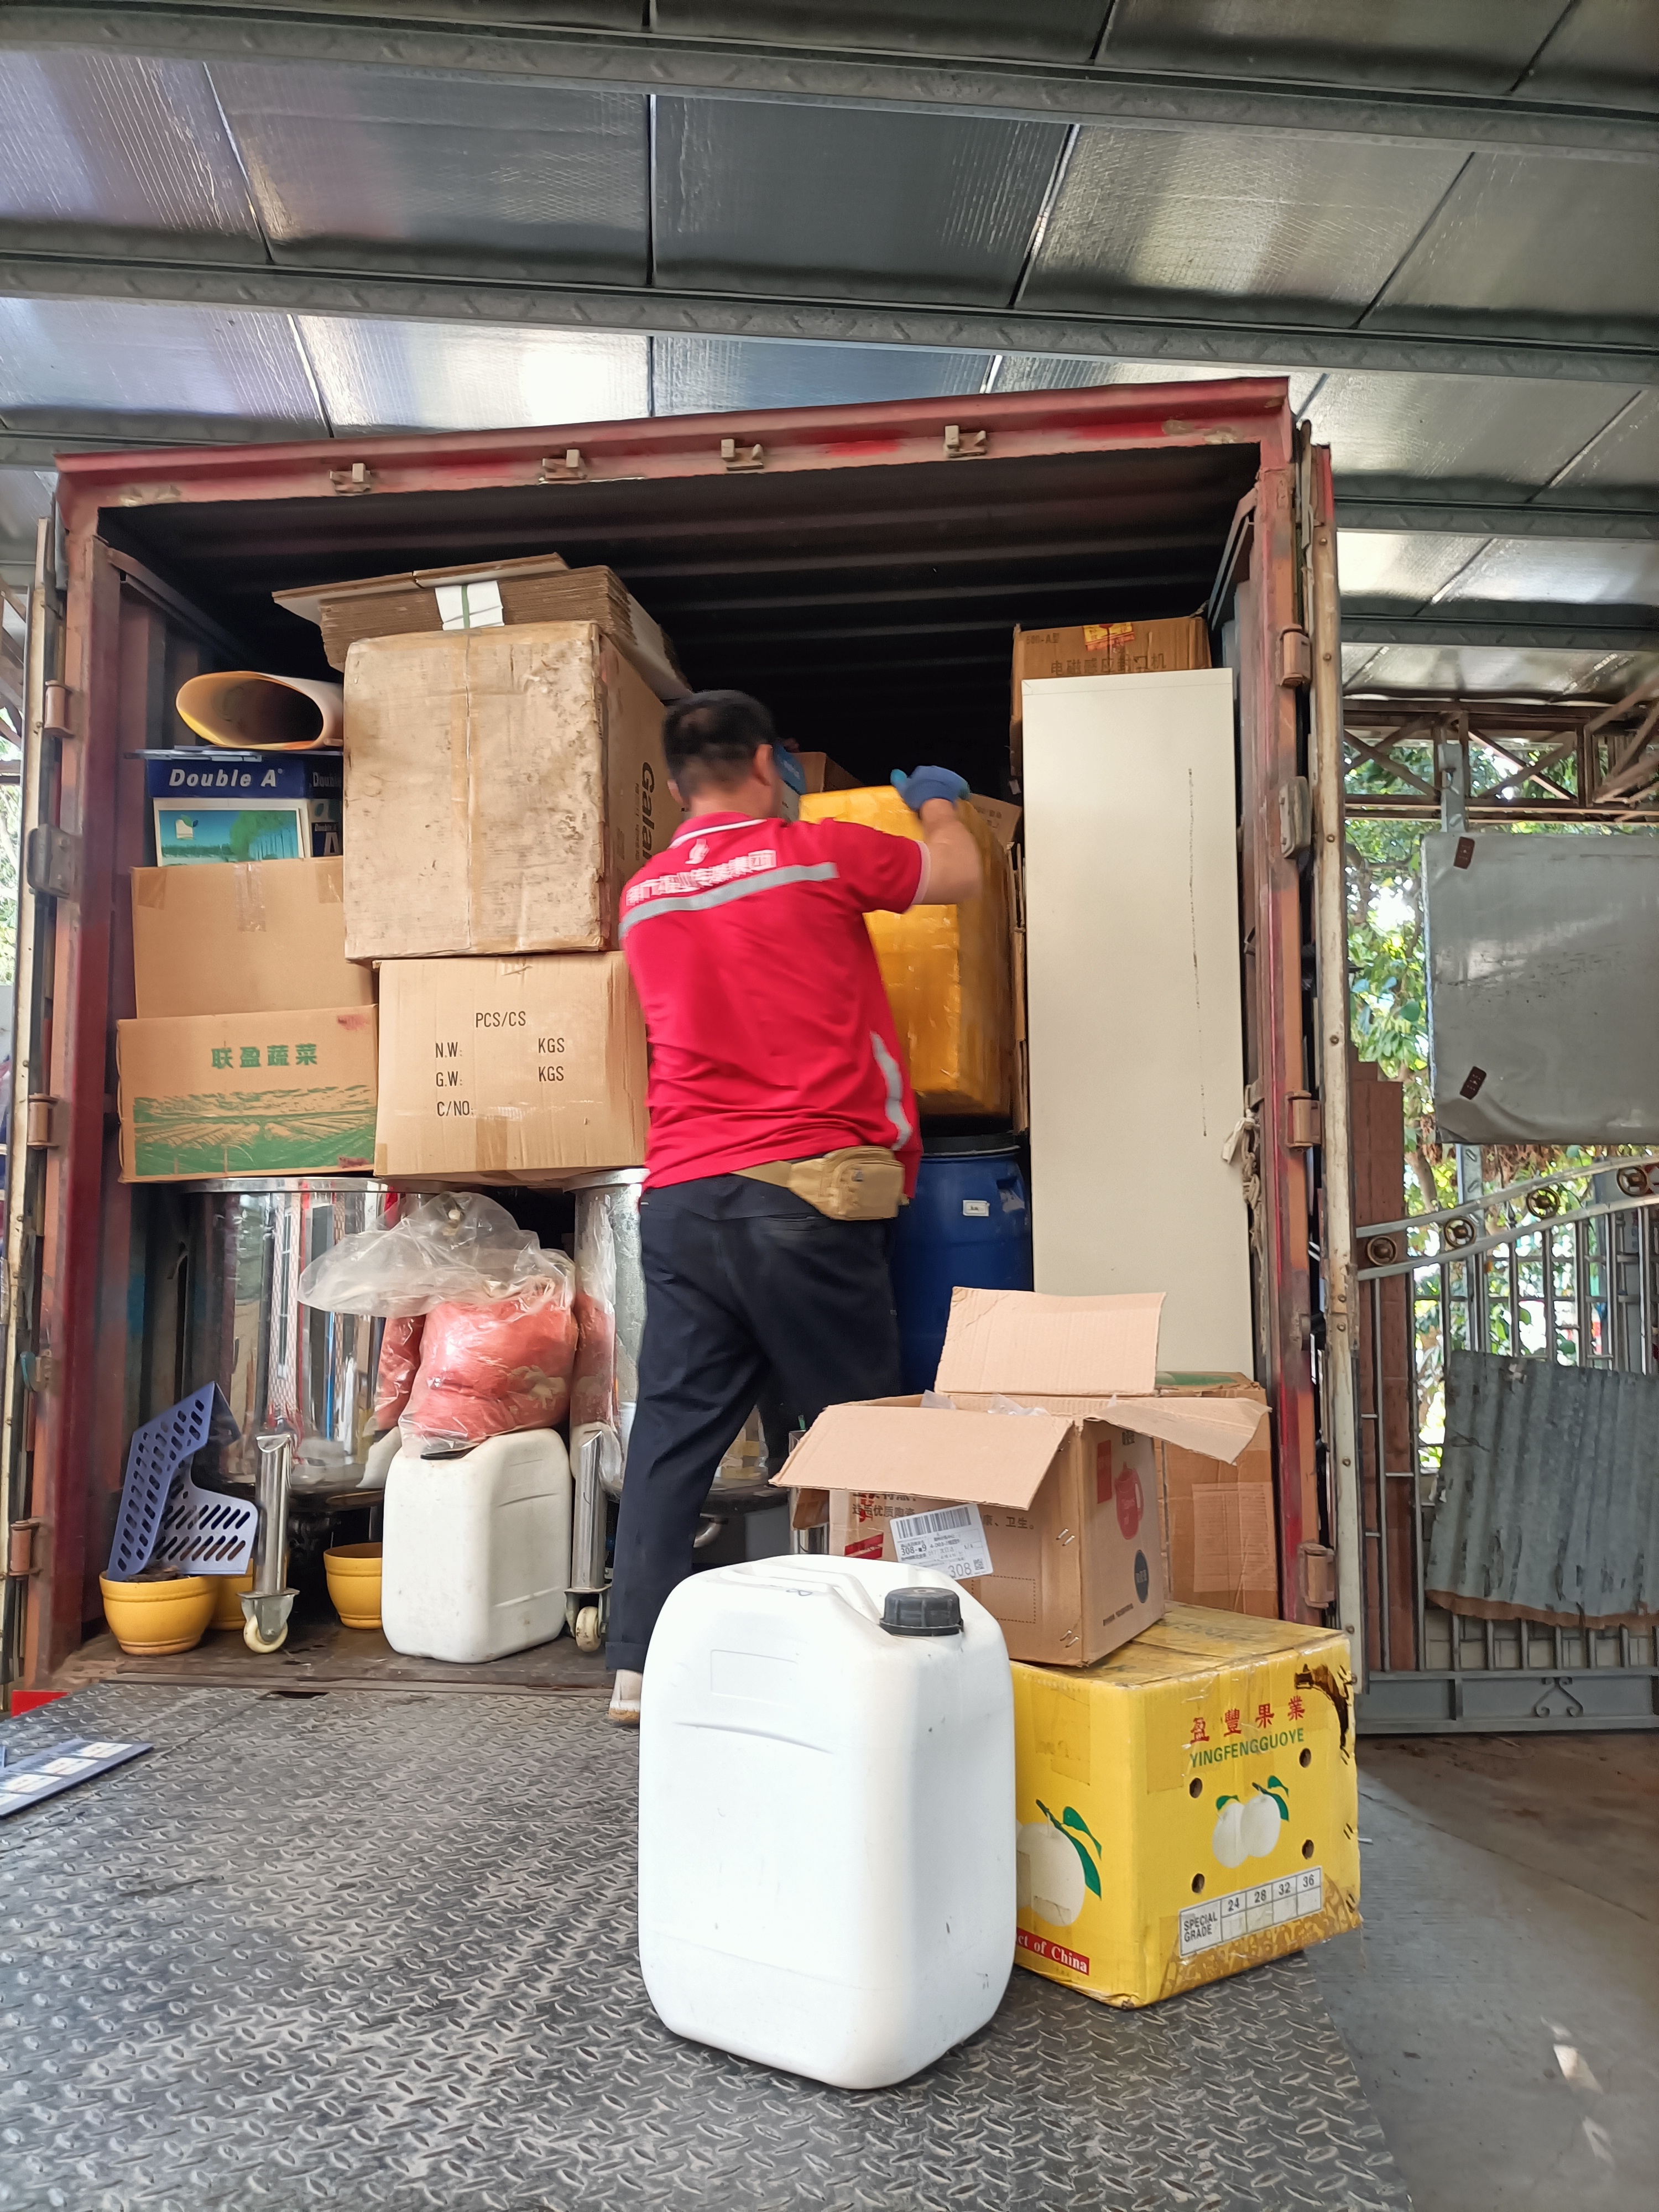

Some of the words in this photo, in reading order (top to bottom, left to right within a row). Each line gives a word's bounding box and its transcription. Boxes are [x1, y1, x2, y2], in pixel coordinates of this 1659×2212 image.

[169, 768, 252, 787] Double
[260, 769, 277, 787] A
[475, 1010, 526, 1028] PCS/CS
[538, 1037, 565, 1053] KGS
[211, 1042, 318, 1070] 联盈蔬菜
[538, 1066, 565, 1082] KGS
[947, 1562, 972, 1579] 308
[1190, 1694, 1306, 1745] 盈豐果業
[1190, 1727, 1305, 1768] YINGFENGGUOYE
[1228, 1897, 1240, 1912] 24
[1254, 1889, 1267, 1903] 28
[1278, 1881, 1291, 1896] 32
[1302, 1874, 1315, 1888] 36
[1183, 1911, 1218, 1932] SPECIAL
[1183, 1924, 1213, 1943] GRADE
[1033, 1940, 1047, 1955] of
[1051, 1945, 1088, 1974] China
